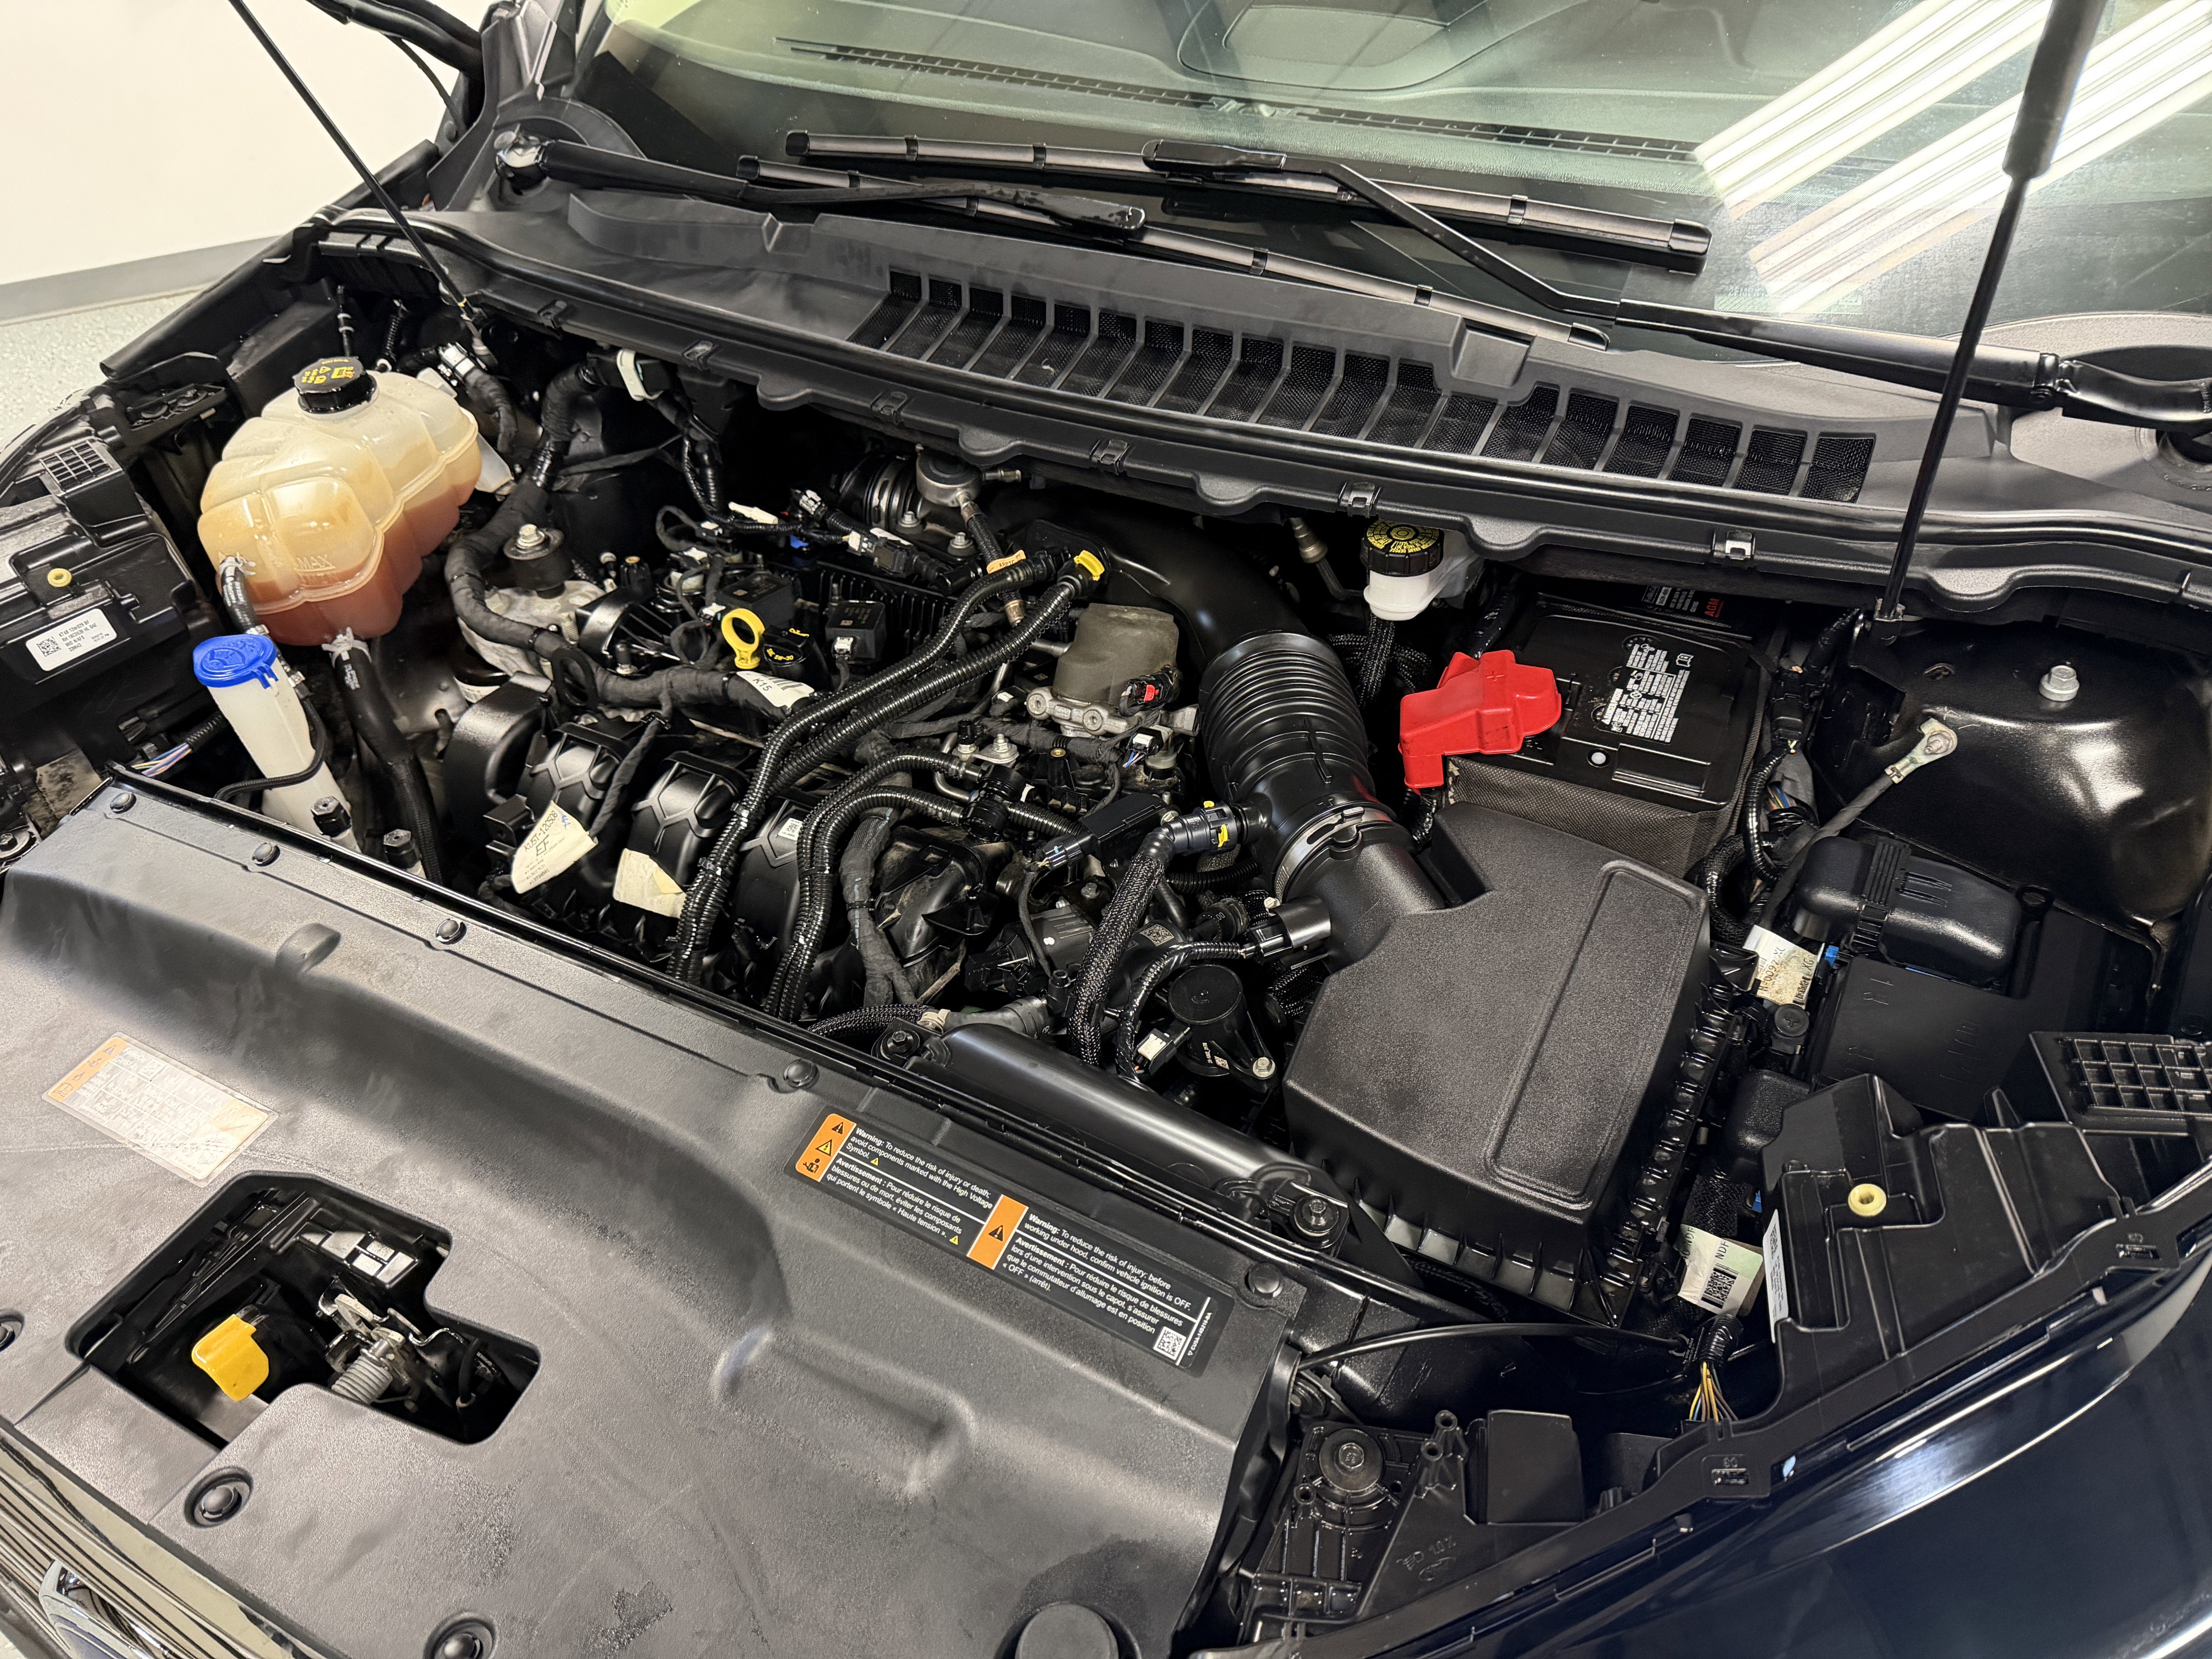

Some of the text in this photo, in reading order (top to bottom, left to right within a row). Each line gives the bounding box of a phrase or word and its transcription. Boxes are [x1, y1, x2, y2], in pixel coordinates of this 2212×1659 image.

[1704, 598, 1720, 617] AGM
[752, 678, 773, 691] K15
[1802, 957, 1814, 970] XG
[846, 1142, 870, 1159] Symbol.
[850, 1136, 993, 1209] avoid components marked with the High Voltage
[855, 1127, 884, 1146] Warning:
[885, 1141, 893, 1150] To
[893, 1147, 914, 1160] reduce
[915, 1156, 925, 1166] the
[925, 1162, 937, 1172] risk
[945, 1171, 963, 1185] injury
[970, 1185, 991, 1199] death;
[826, 1173, 838, 1182] qui
[836, 1178, 859, 1193] portent
[859, 1188, 866, 1196] le
[865, 1193, 891, 1209] symbole
[897, 1207, 917, 1221] Haute
[917, 1218, 940, 1233] tension
[831, 1164, 861, 1183] blessures
[895, 1197, 914, 1209] éviter
[913, 1205, 924, 1215] les
[923, 1212, 962, 1234] composants
[835, 1157, 883, 1184] Avertissement
[886, 1181, 902, 1194] Pour
[902, 1190, 924, 1205] réduire
[924, 1200, 931, 1208] le
[931, 1205, 951, 1218] risque
[951, 1215, 960, 1223] de
[1008, 1264, 1024, 1275] OFF
[1029, 1275, 1050, 1291] (arrêt).
[1011, 1244, 1024, 1255] lors
[1024, 1252, 1042, 1265] d'une
[1042, 1262, 1081, 1285] intervention
[1081, 1281, 1098, 1293] sous
[1098, 1288, 1105, 1297] le
[1127, 1305, 1159, 1324] s'assurer
[1015, 1237, 1065, 1266] Avertissement
[1068, 1263, 1086, 1276] Pour
[1085, 1273, 1109, 1289] réduire
[1110, 1284, 1117, 1293] le
[1117, 1289, 1139, 1304] risque
[1139, 1300, 1149, 1309] de
[1149, 1304, 1183, 1326] blessures
[1024, 1222, 1191, 1311] working under hood, confirm vehicle ignition is OFF.
[1028, 1213, 1060, 1234] Warning:
[1061, 1229, 1069, 1238] To
[1069, 1235, 1093, 1250] reduce
[1093, 1246, 1105, 1256] the
[1105, 1253, 1118, 1263] risk
[1148, 1273, 1171, 1289] before
[1715, 1240, 1729, 1260] NDF
[1006, 1254, 1155, 1334] que le commutateur d'allumage est en position
